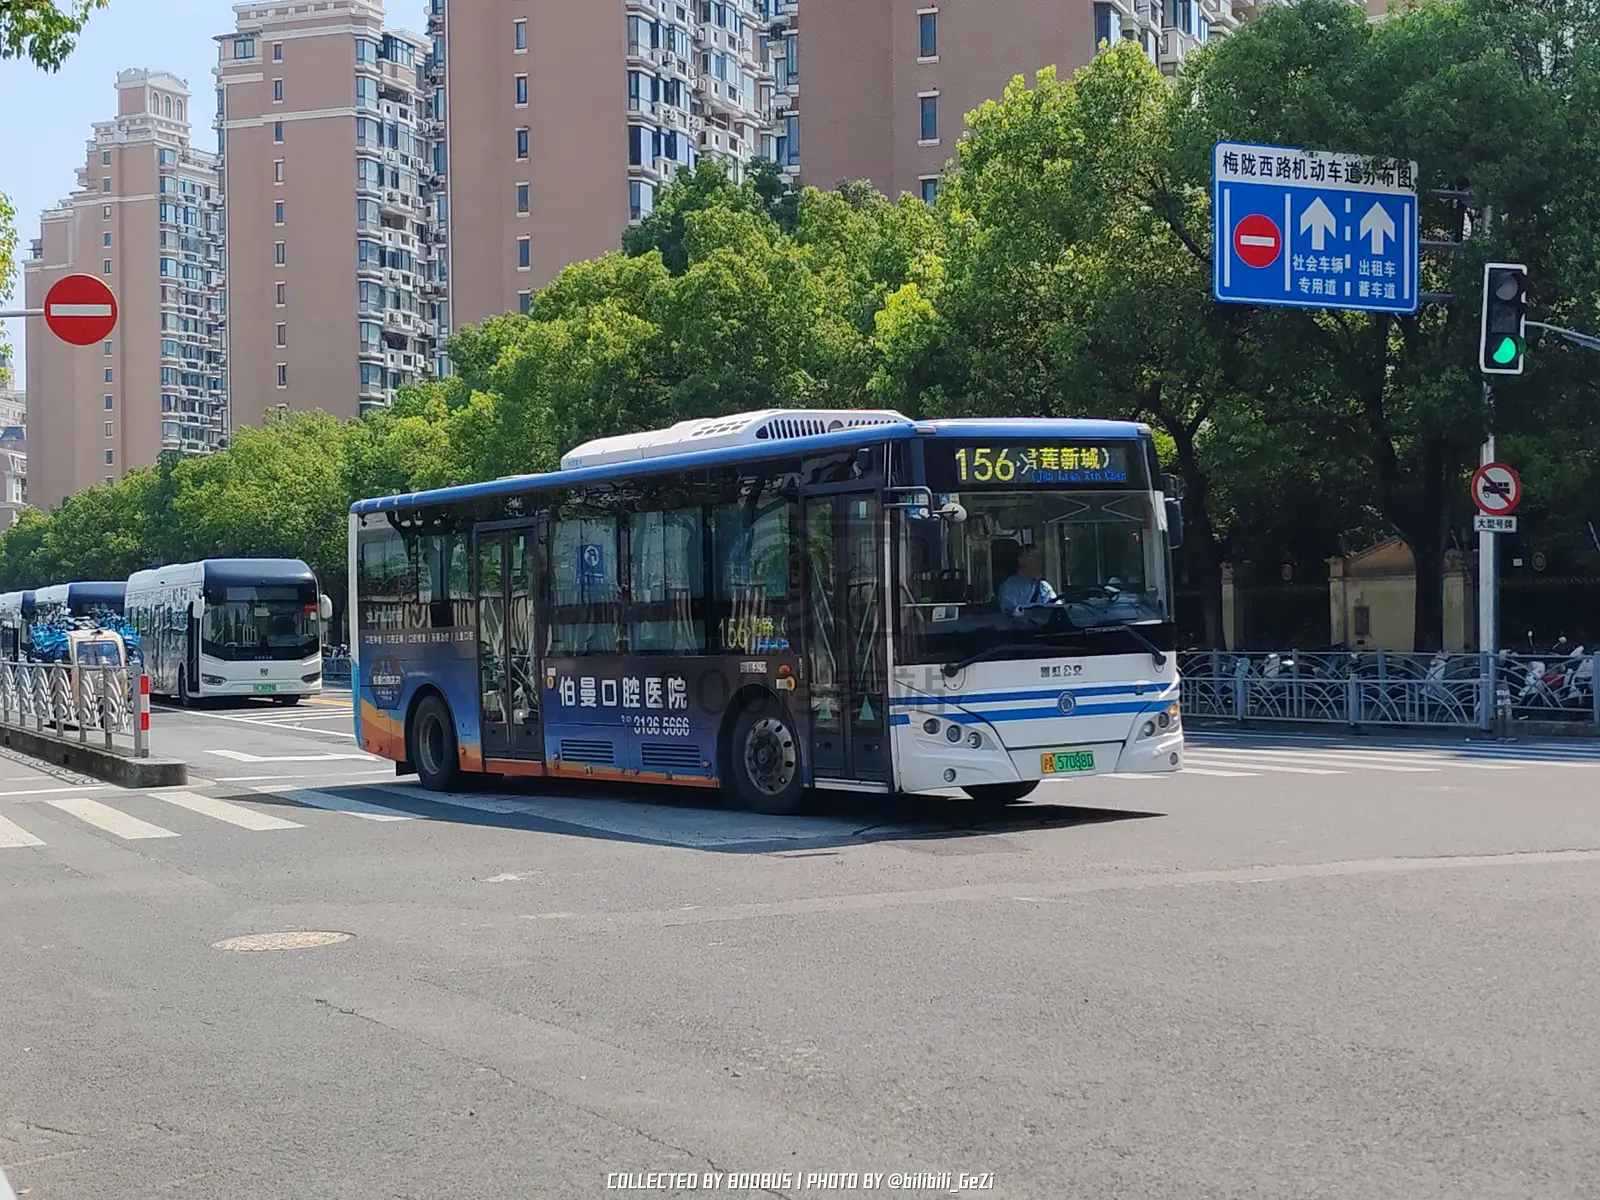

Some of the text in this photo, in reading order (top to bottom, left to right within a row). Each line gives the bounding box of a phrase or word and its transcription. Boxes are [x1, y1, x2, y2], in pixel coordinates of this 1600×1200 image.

[1222, 151, 1412, 189] 梅陇西路机动车道分布图
[1292, 253, 1344, 274] 社会车辆
[1358, 259, 1396, 278] 出租车
[1298, 277, 1337, 296] 专用道
[1358, 280, 1396, 300] 蓄车道
[955, 447, 1015, 482] 156
[1477, 518, 1513, 530] 大型号牌
[558, 675, 688, 710] 伯曼口腔医院
[633, 714, 660, 735] 3136
[662, 715, 691, 737] 5666
